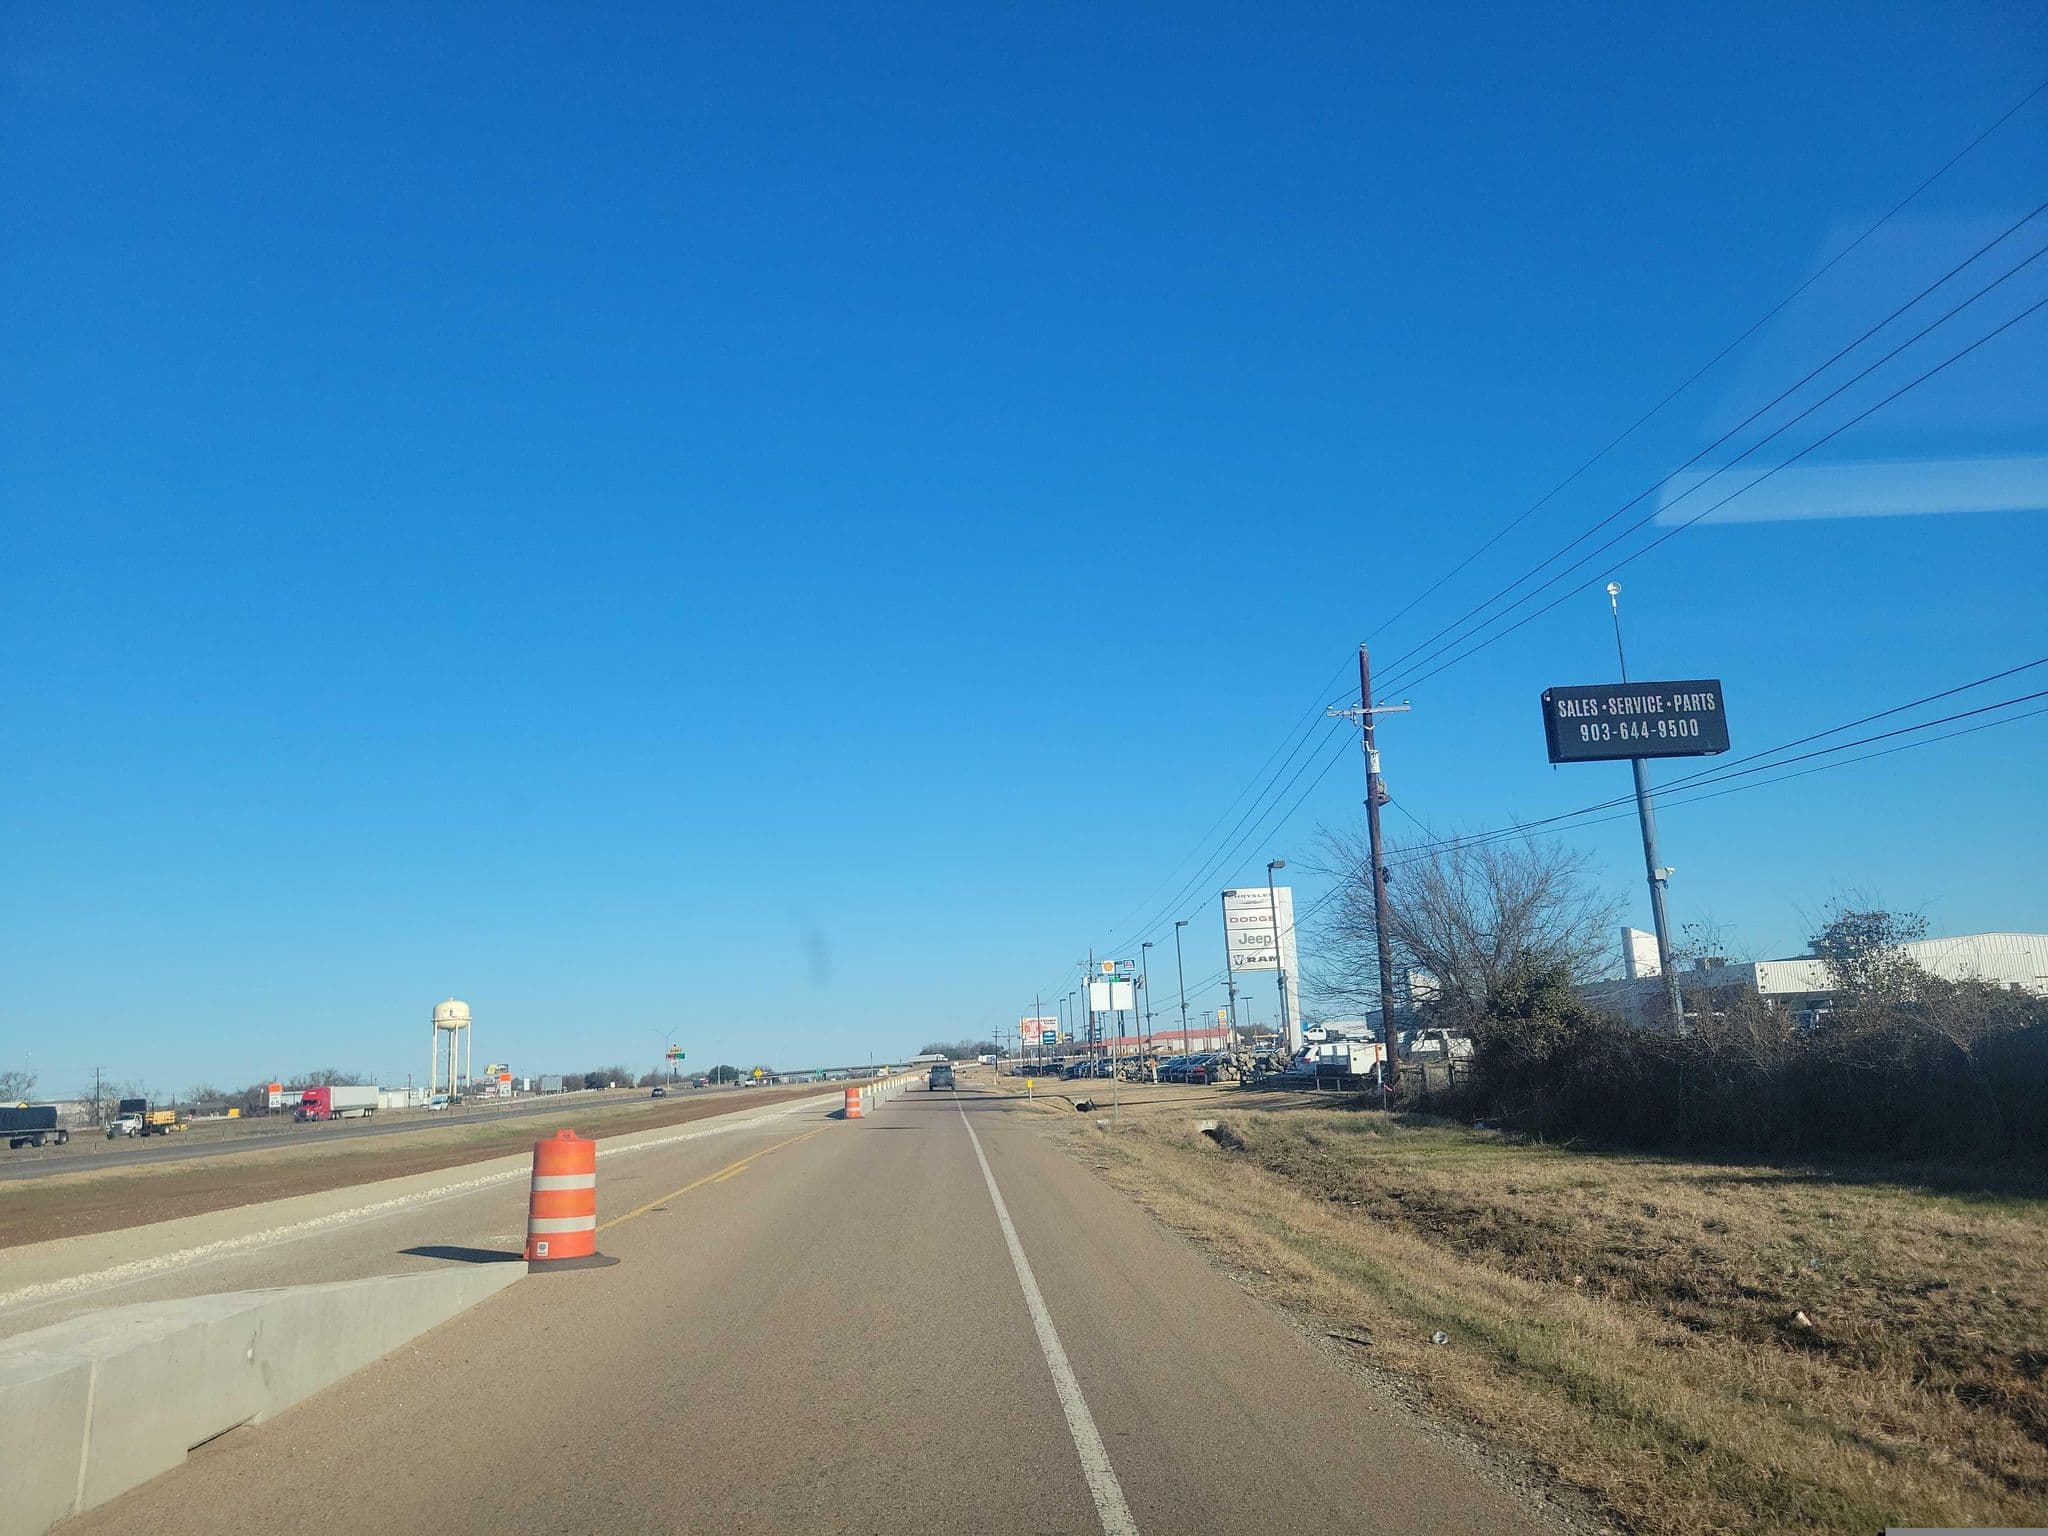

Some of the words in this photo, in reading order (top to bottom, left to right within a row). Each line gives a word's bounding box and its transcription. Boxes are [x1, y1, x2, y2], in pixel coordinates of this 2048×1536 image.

[1558, 699, 1598, 718] SALES
[1608, 695, 1664, 716] SERVICE
[1673, 692, 1716, 712] PARTS
[1580, 719, 1699, 742] 903-644-9500
[1239, 933, 1272, 946] Jeep
[1246, 955, 1280, 963] RAM
